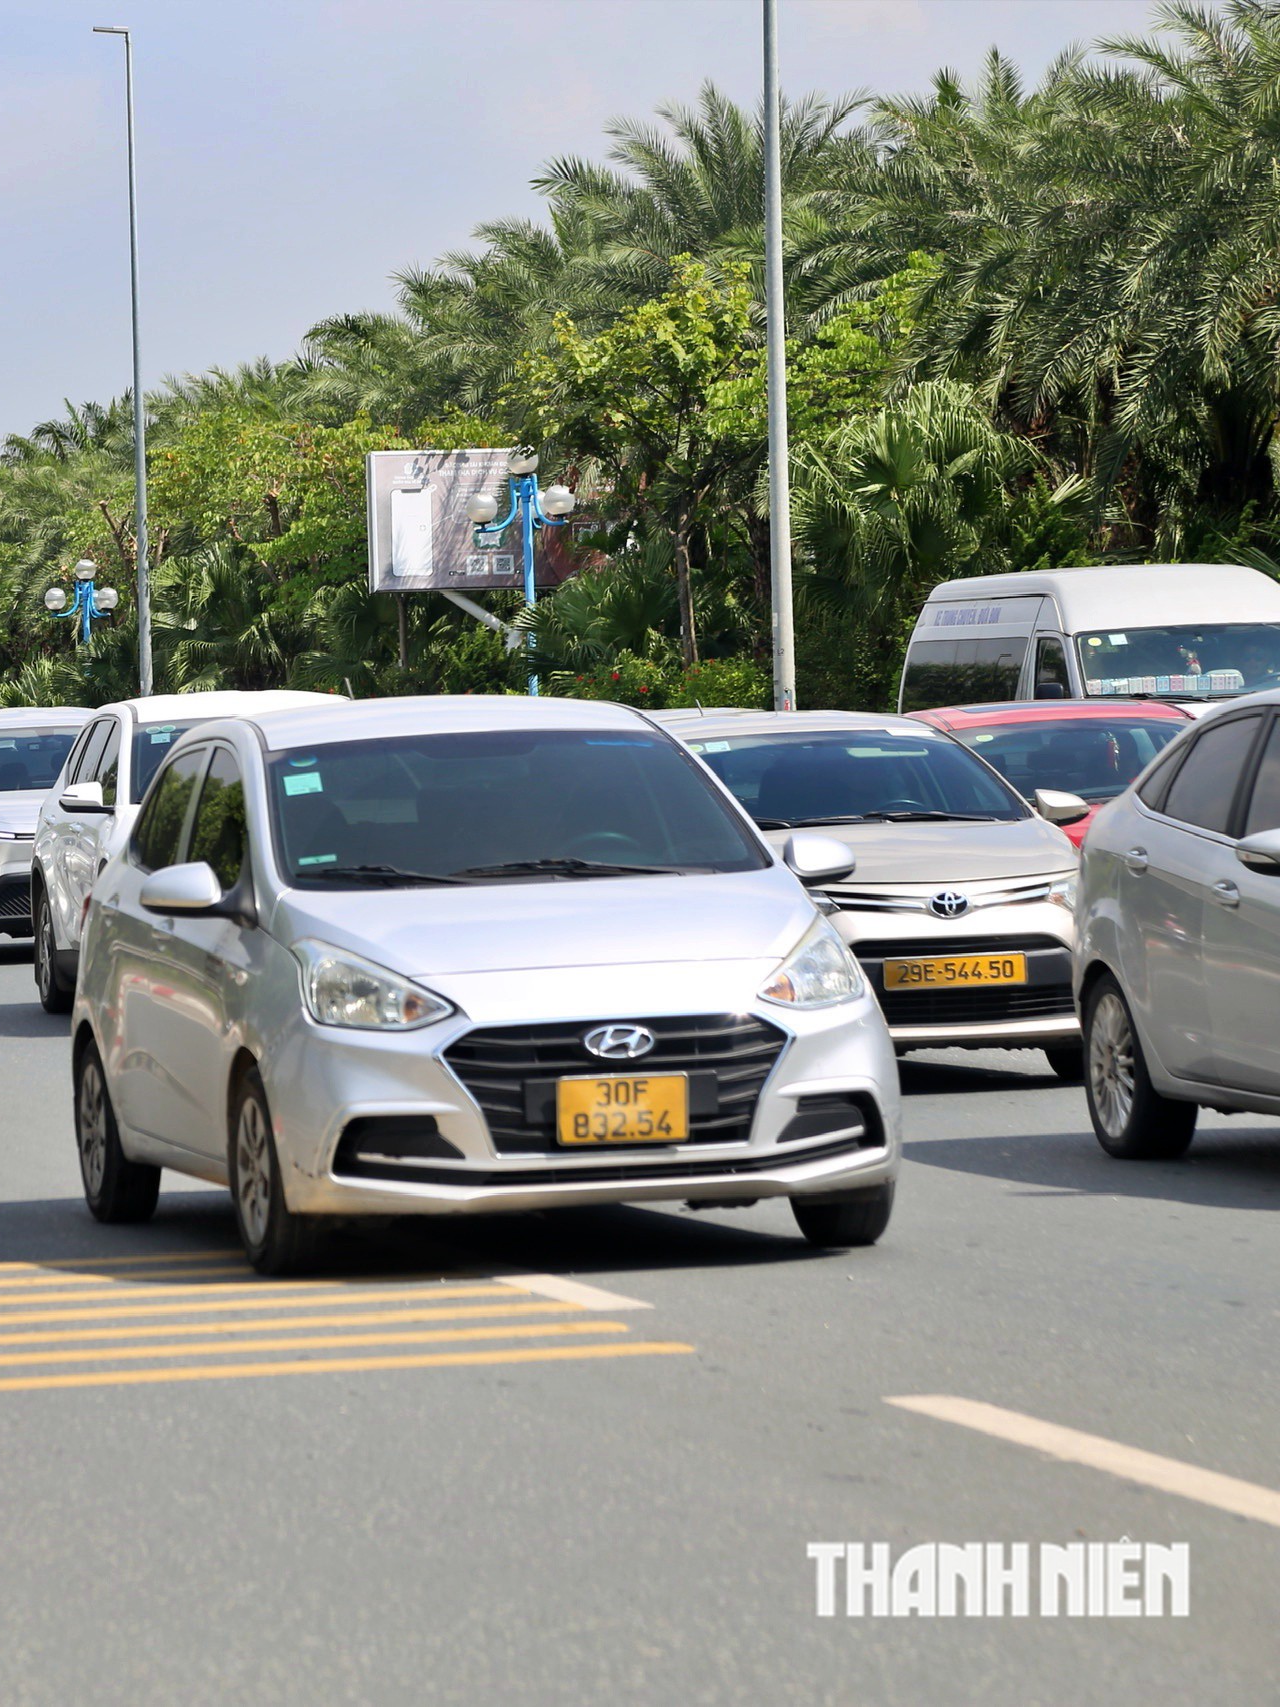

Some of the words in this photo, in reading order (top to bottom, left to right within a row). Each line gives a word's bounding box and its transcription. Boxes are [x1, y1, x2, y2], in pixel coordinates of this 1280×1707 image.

[897, 959, 1015, 984] 29E-544.50
[595, 1080, 650, 1107] 30F
[573, 1110, 673, 1141] 832.54
